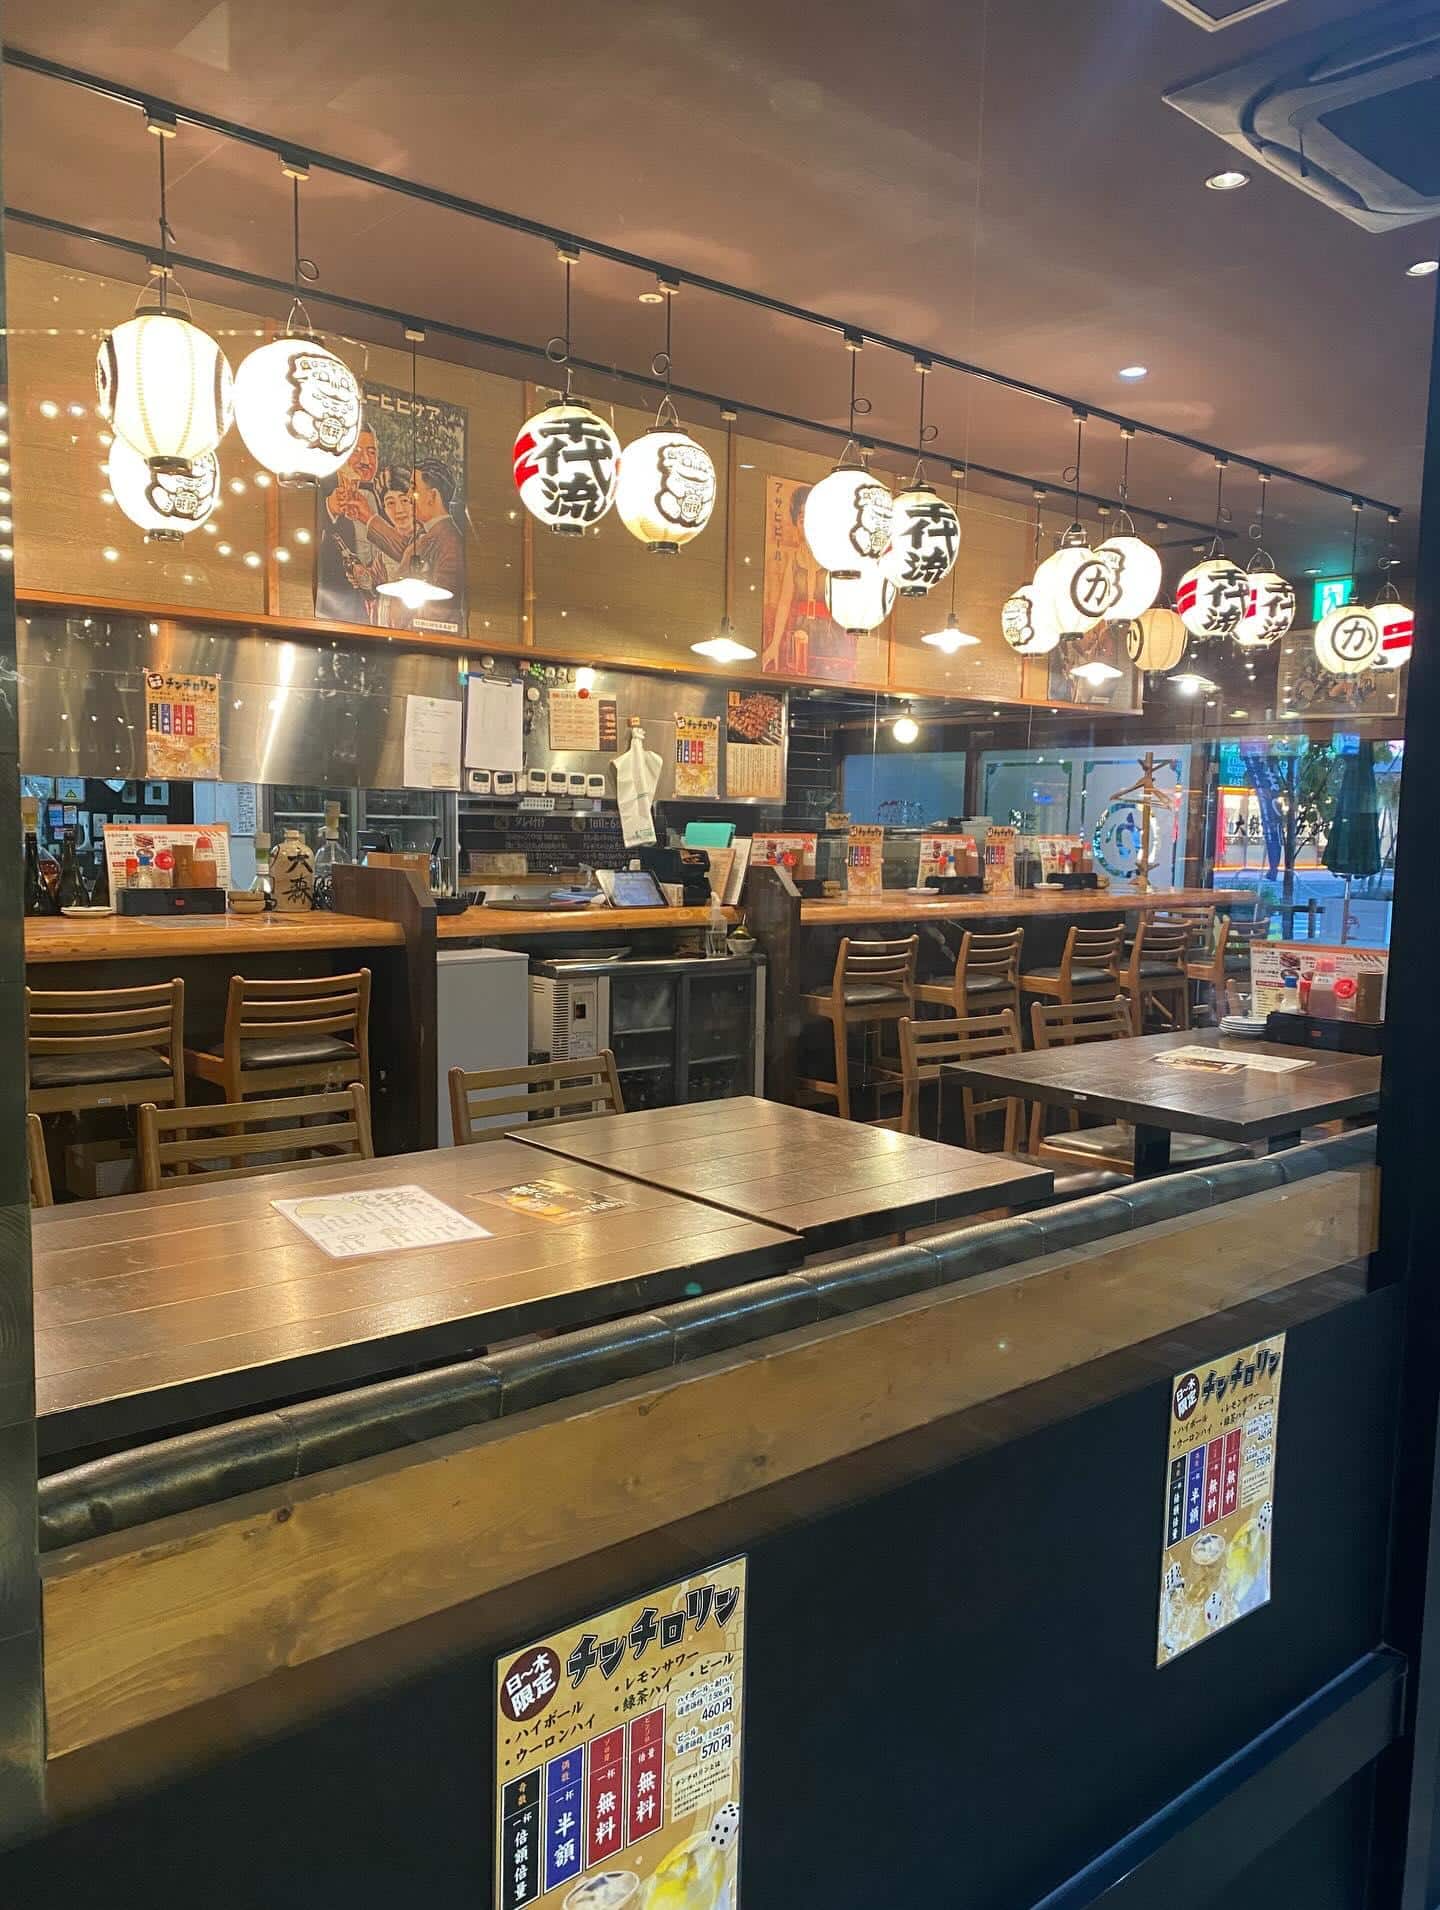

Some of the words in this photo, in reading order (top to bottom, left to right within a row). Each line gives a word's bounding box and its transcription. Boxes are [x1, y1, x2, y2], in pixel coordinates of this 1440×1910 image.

[1340, 621, 1373, 651] か
[567, 1584, 740, 1690] チンチロリン
[511, 1667, 556, 1718] 限定
[702, 1696, 732, 1721] 460円
[701, 1734, 731, 1759] 570円
[595, 1791, 617, 1846] 無料
[636, 1770, 656, 1823] 無料
[553, 1811, 576, 1868] 半額
